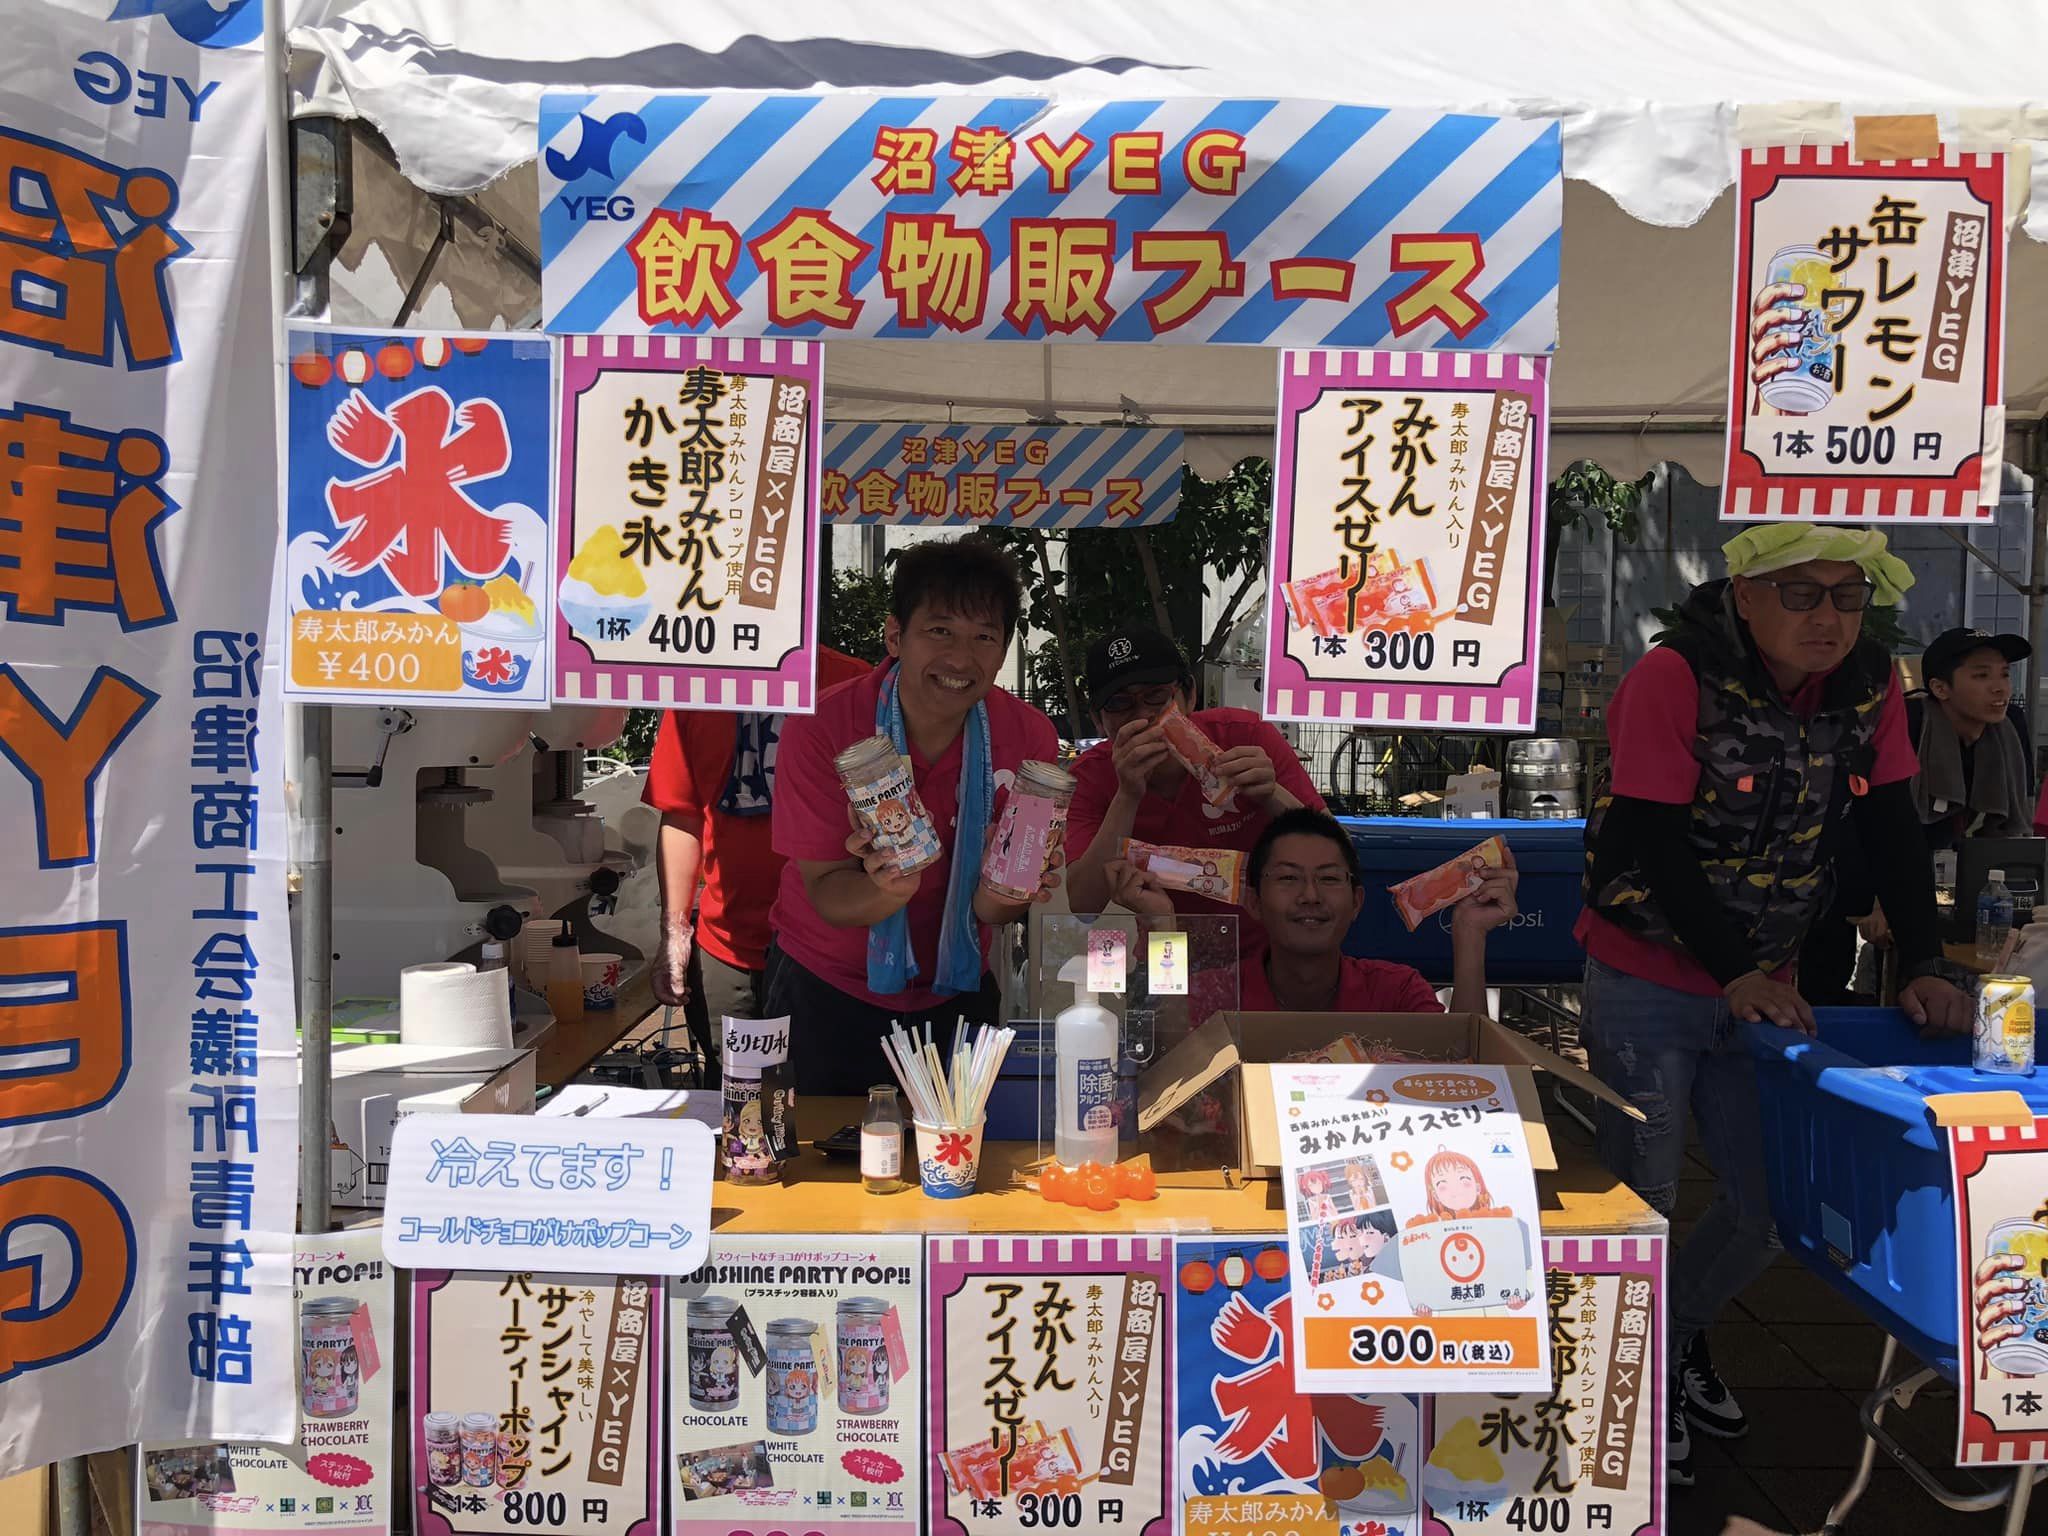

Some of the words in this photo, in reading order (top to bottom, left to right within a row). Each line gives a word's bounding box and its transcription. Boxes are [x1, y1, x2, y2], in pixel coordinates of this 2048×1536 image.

[872, 125, 1246, 197] 沼津YEG
[560, 195, 635, 222] YEG
[626, 206, 1489, 341] 飲食物販ブース
[1818, 226, 1873, 394] サワー
[1866, 194, 1928, 424] 缶レモン
[1931, 218, 1982, 372] 沼津YEG
[901, 436, 1050, 466] 沼津YEG
[1388, 396, 1440, 517] みかん
[1772, 429, 1814, 460] 1本
[1825, 425, 1895, 465] 500
[1913, 431, 1942, 461] 円
[326, 385, 513, 599] 氷
[620, 397, 677, 567] かき氷
[677, 365, 729, 613] 寿太郎みかん
[726, 375, 747, 597] 寿太郎みかんシロップ使用
[1445, 401, 1470, 549] 寿太郎みかん入り
[1334, 397, 1383, 633] アイスゼリー
[297, 616, 459, 647] 寿太郎みかん
[597, 616, 632, 643] 1杯
[648, 614, 716, 654] 400
[733, 625, 760, 652] 円
[1311, 635, 1347, 658] 1本
[1364, 630, 1435, 671] 300
[1452, 640, 1480, 668] 円
[317, 651, 420, 684] ¥400
[475, 646, 511, 685] 氷
[1079, 1072, 1114, 1094] 除菌
[1299, 1104, 1504, 1155] みかんアイスゼリー
[934, 1133, 973, 1166] 氷
[399, 1215, 692, 1250] コールドチョコがけポップコーン
[779, 1266, 849, 1284] PARTY
[852, 1267, 911, 1285] POP!!
[577, 1289, 596, 1422] 冷やして美味しい
[1033, 1281, 1075, 1391] みかん
[1086, 1284, 1104, 1419] 寿太郎みかん入り
[1352, 1329, 1434, 1362] 300
[499, 1271, 534, 1488] パーティーポップ
[538, 1287, 577, 1477] サンシャイン
[985, 1283, 1026, 1497] アイスゼリー
[1579, 1274, 1597, 1479] 寿太郎みかんシロップ使用
[682, 1415, 748, 1427] CHOCOLATE
[2001, 1391, 2043, 1416] 1本
[301, 1420, 369, 1434] STRAWBERRY
[301, 1434, 369, 1447] CHOCOLATE
[836, 1419, 899, 1431] STRAWBERRY
[836, 1431, 899, 1443] CHOCOLATE
[229, 1446, 261, 1456] WHITE
[229, 1458, 289, 1469] CHOCOLATE
[767, 1441, 798, 1452] WHITE
[767, 1453, 824, 1464] CHOCOLATE
[503, 1491, 566, 1526] 800
[582, 1498, 608, 1524] 円
[970, 1499, 1003, 1519] 1本
[1019, 1493, 1082, 1528] 300
[1098, 1498, 1123, 1524] 円
[1189, 1501, 1338, 1525] 寿太郎みかん
[1456, 1501, 1489, 1522] 1杯
[1506, 1497, 1570, 1532] 400
[1587, 1503, 1612, 1529] 円
